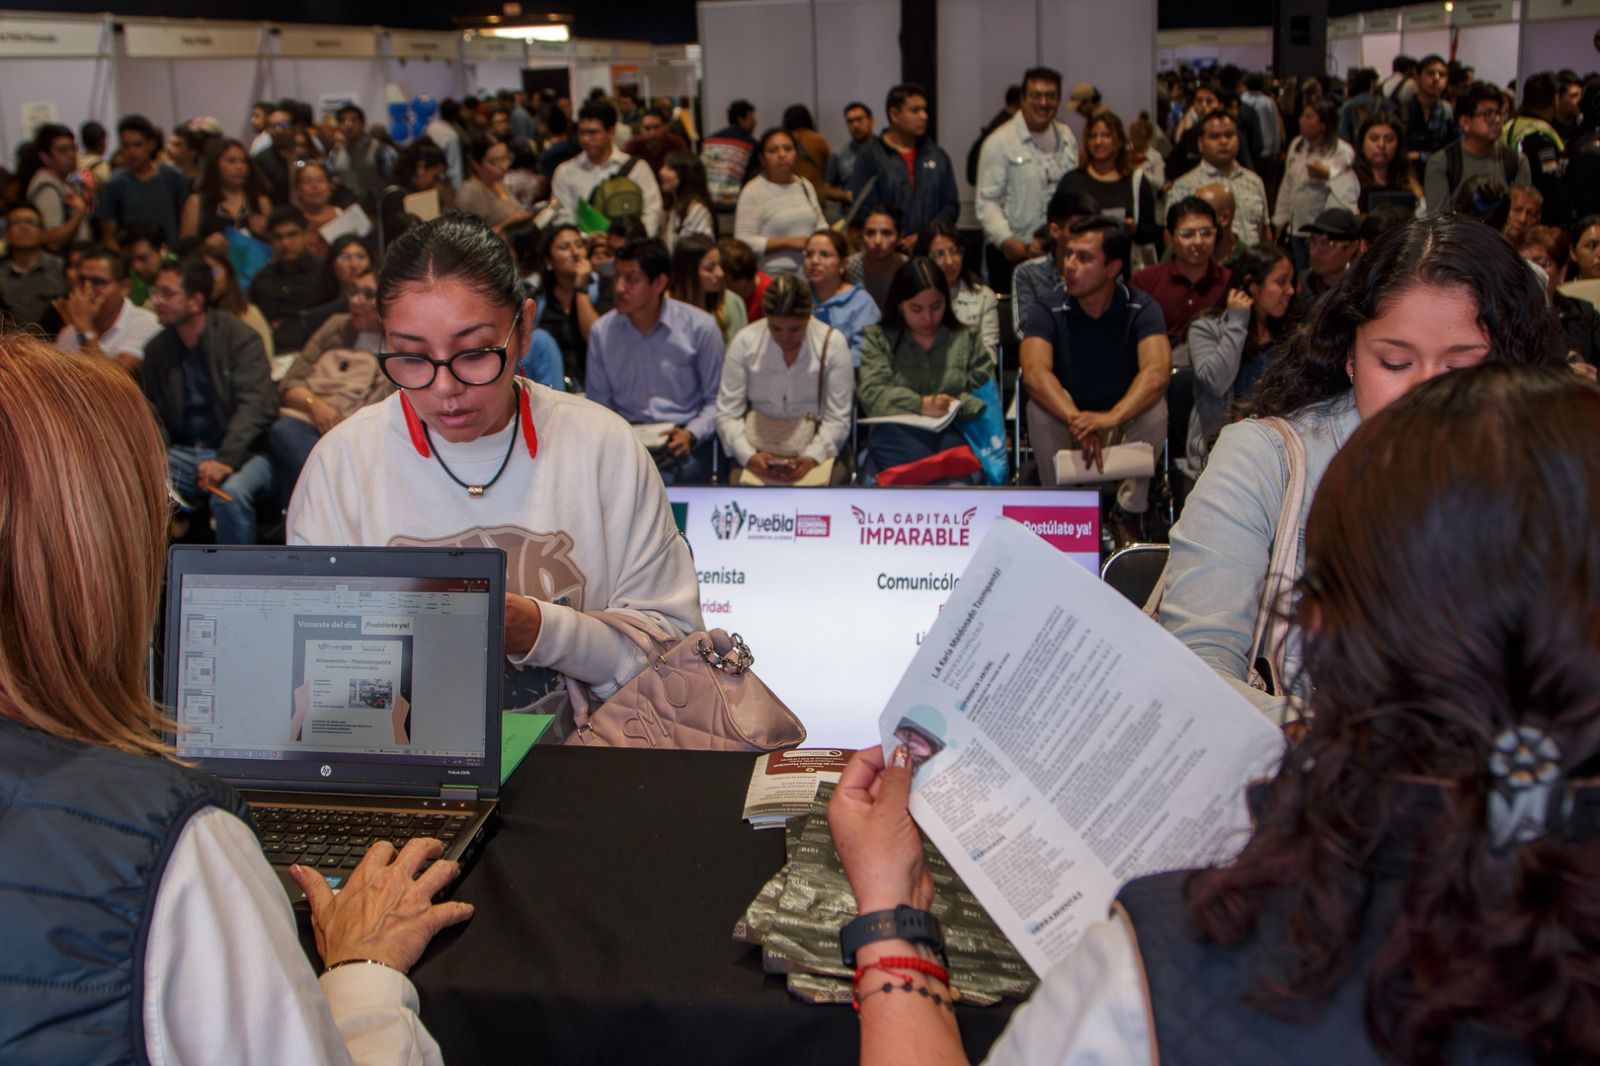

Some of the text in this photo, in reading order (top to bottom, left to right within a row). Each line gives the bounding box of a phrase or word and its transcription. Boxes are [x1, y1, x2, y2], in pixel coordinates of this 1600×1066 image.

[747, 513, 795, 532] Puebla
[867, 512, 961, 525] LA CAPITAL
[859, 526, 970, 546] IMPARABLE
[1075, 521, 1092, 539] ya!
[948, 608, 979, 649] Maldonado
